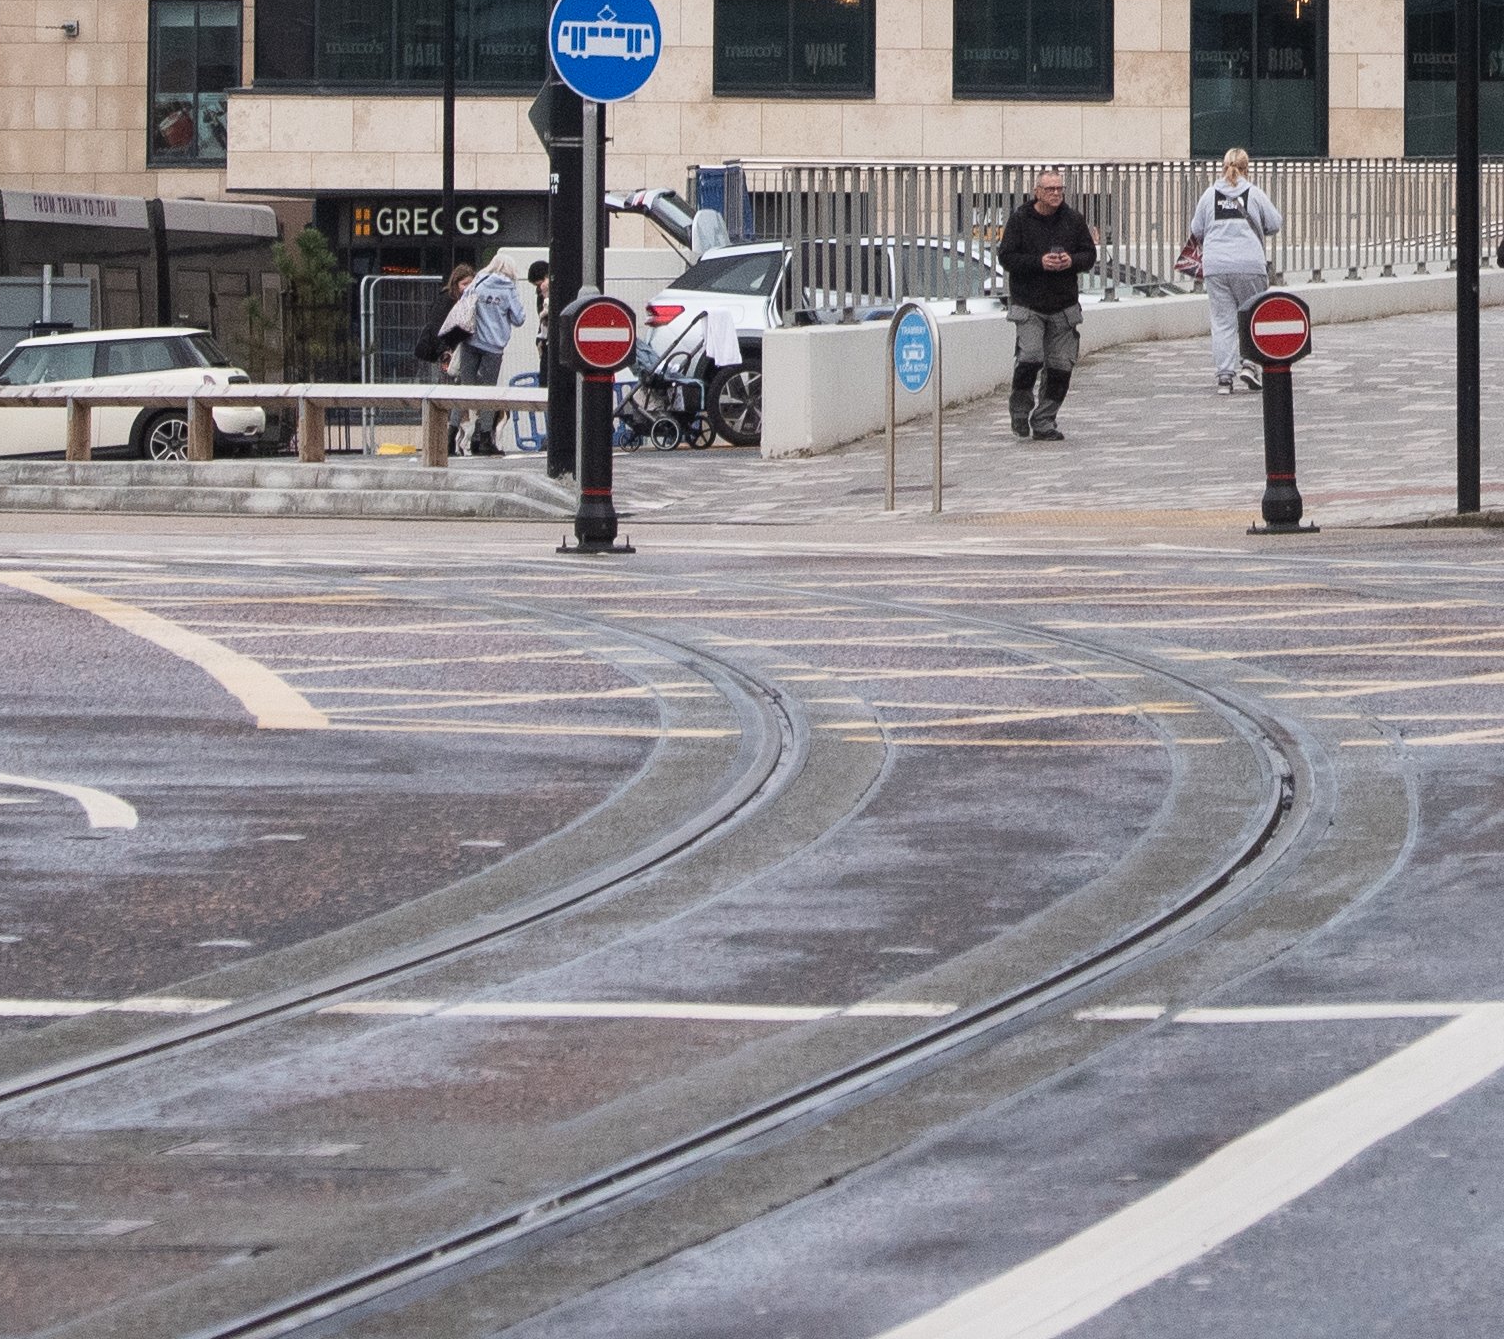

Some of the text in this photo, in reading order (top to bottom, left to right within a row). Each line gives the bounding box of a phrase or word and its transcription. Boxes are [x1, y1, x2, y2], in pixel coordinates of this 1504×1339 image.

[403, 43, 461, 66] GARL
[805, 43, 847, 67] WINE
[1040, 45, 1093, 69] WINGS
[1268, 47, 1303, 71] RIBS
